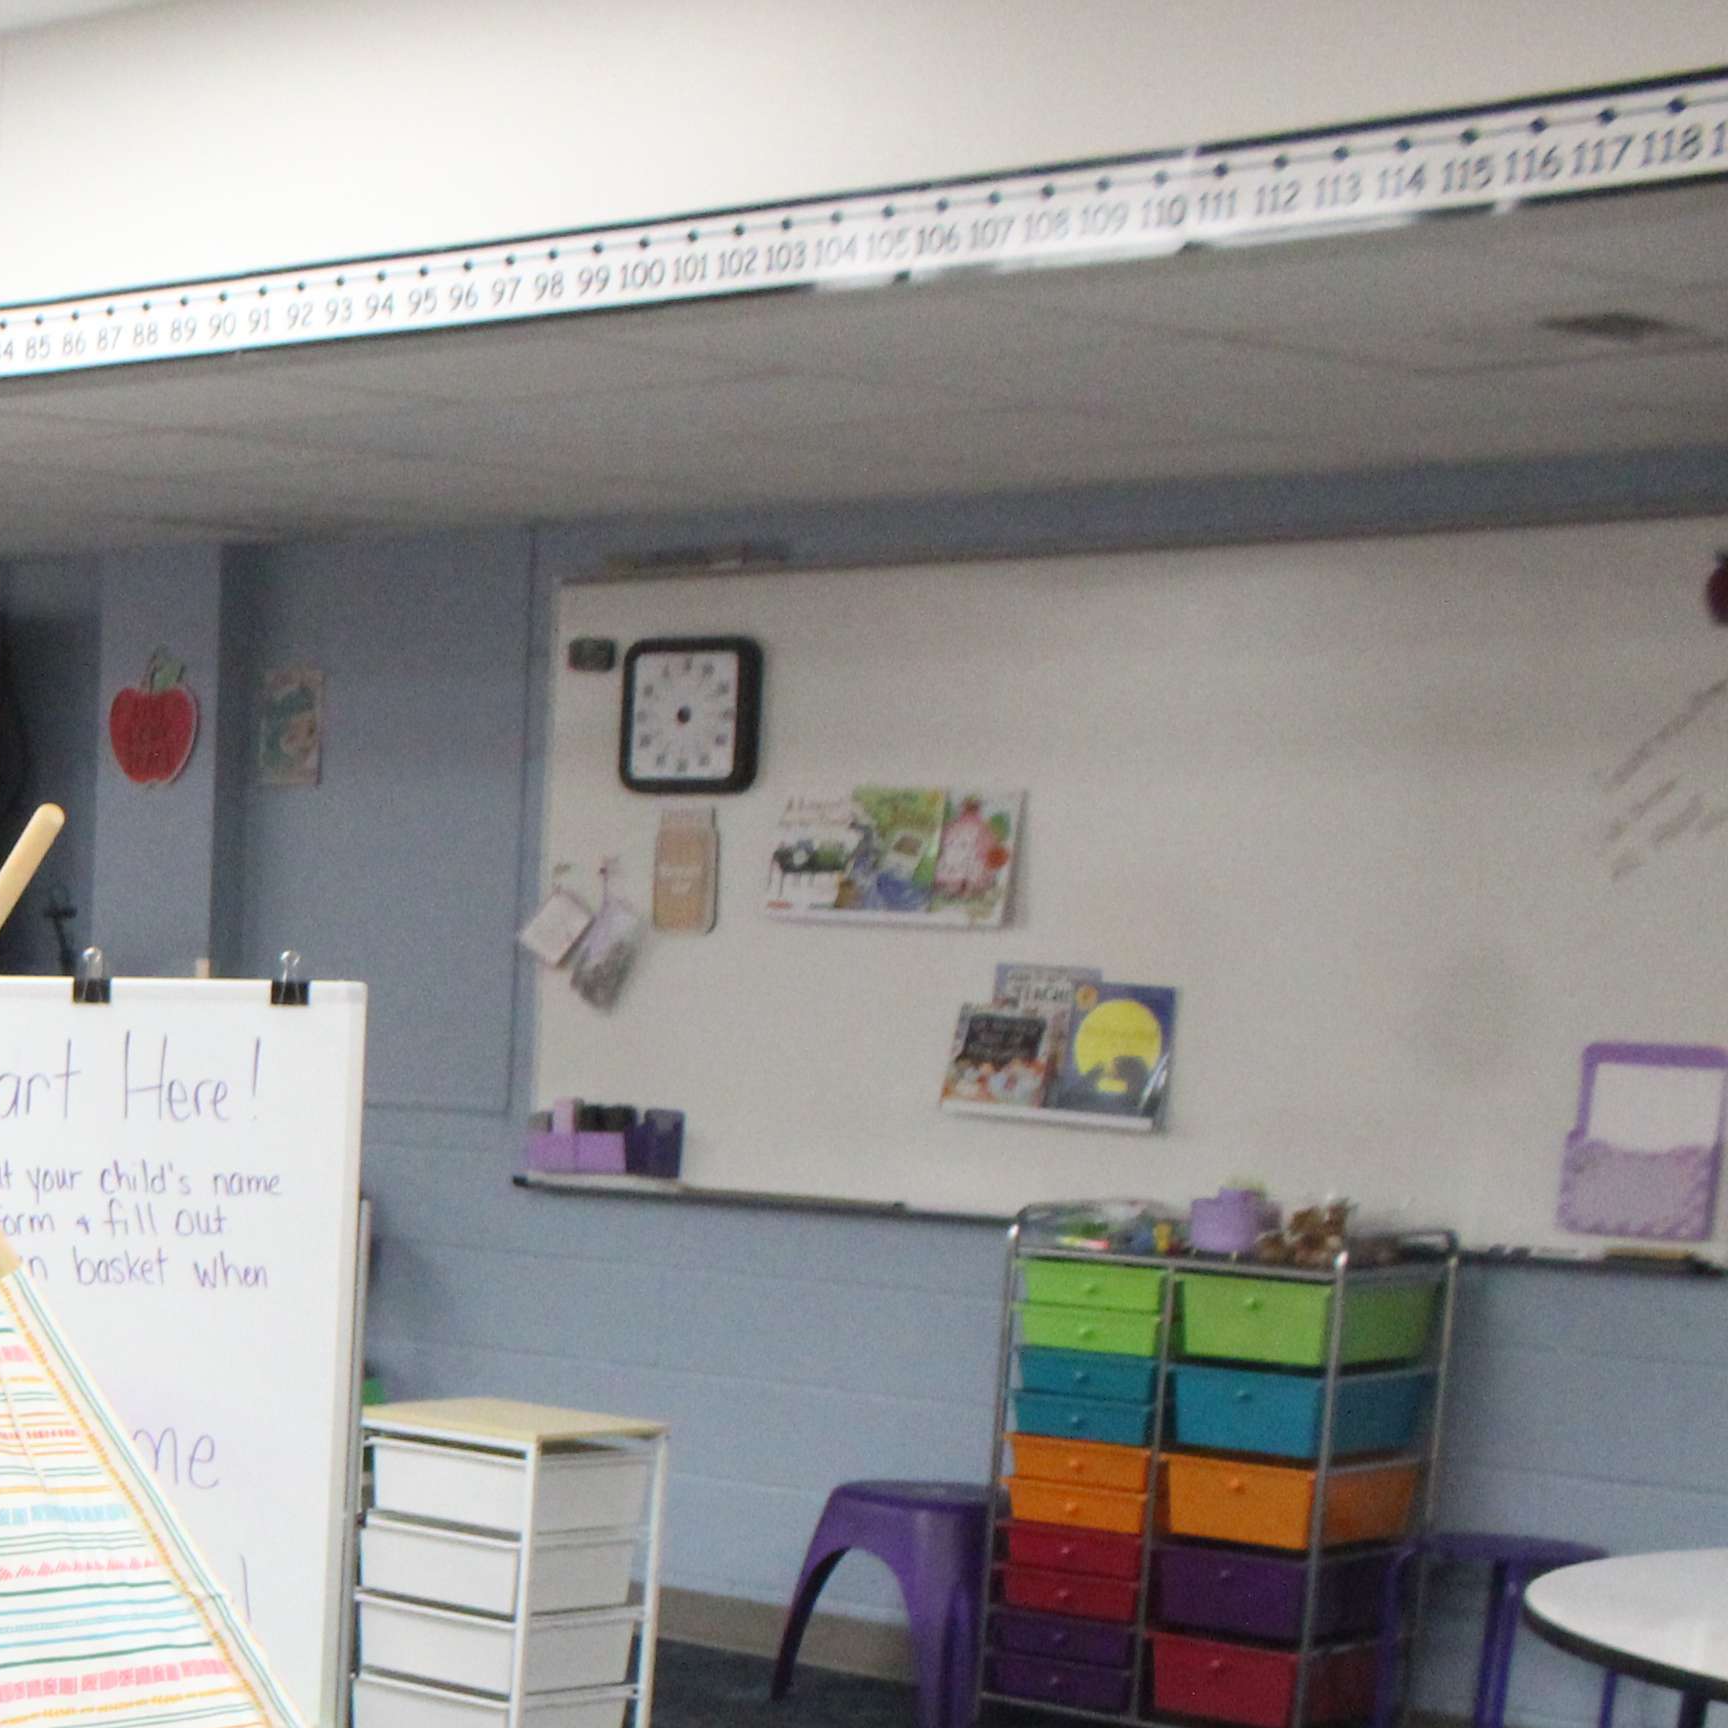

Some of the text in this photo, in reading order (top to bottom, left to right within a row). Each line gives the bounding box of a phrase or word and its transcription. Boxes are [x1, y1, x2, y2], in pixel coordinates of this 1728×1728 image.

[25, 334, 50, 359] 85
[62, 329, 85, 355] 86
[97, 325, 121, 351] 87
[133, 321, 158, 347] 88
[170, 316, 197, 342] 89
[209, 311, 236, 338] 90
[249, 307, 270, 333] 91
[287, 302, 313, 329] 92
[326, 297, 352, 324] 93
[366, 292, 394, 320] 94
[408, 287, 437, 315] 95
[449, 282, 477, 310] 96
[492, 276, 521, 305] 97
[534, 271, 564, 301] 98
[578, 266, 610, 296] 99
[621, 259, 665, 291] 100
[673, 254, 707, 285] 101
[718, 247, 757, 279] 102
[766, 241, 806, 274] 103
[814, 235, 857, 268] 104
[867, 228, 909, 262] 105
[916, 222, 958, 256] 106
[970, 215, 1013, 249] 107
[1024, 208, 1070, 243] 108
[1080, 200, 1129, 236] 109
[1143, 193, 1189, 229] 110
[1198, 186, 1237, 222] 111
[1256, 178, 1300, 215] 112
[1316, 170, 1362, 208] 113
[1379, 162, 1426, 200] 114
[1443, 153, 1494, 192] 115
[1506, 144, 1562, 184] 116
[1573, 135, 1632, 176] 117
[1643, 126, 1702, 167] 118
[28, 1166, 83, 1205] your
[99, 1159, 192, 1196] child's
[213, 1171, 282, 1197] name
[104, 1198, 157, 1237] fill
[175, 1204, 228, 1237] out
[72, 1246, 168, 1286] basket
